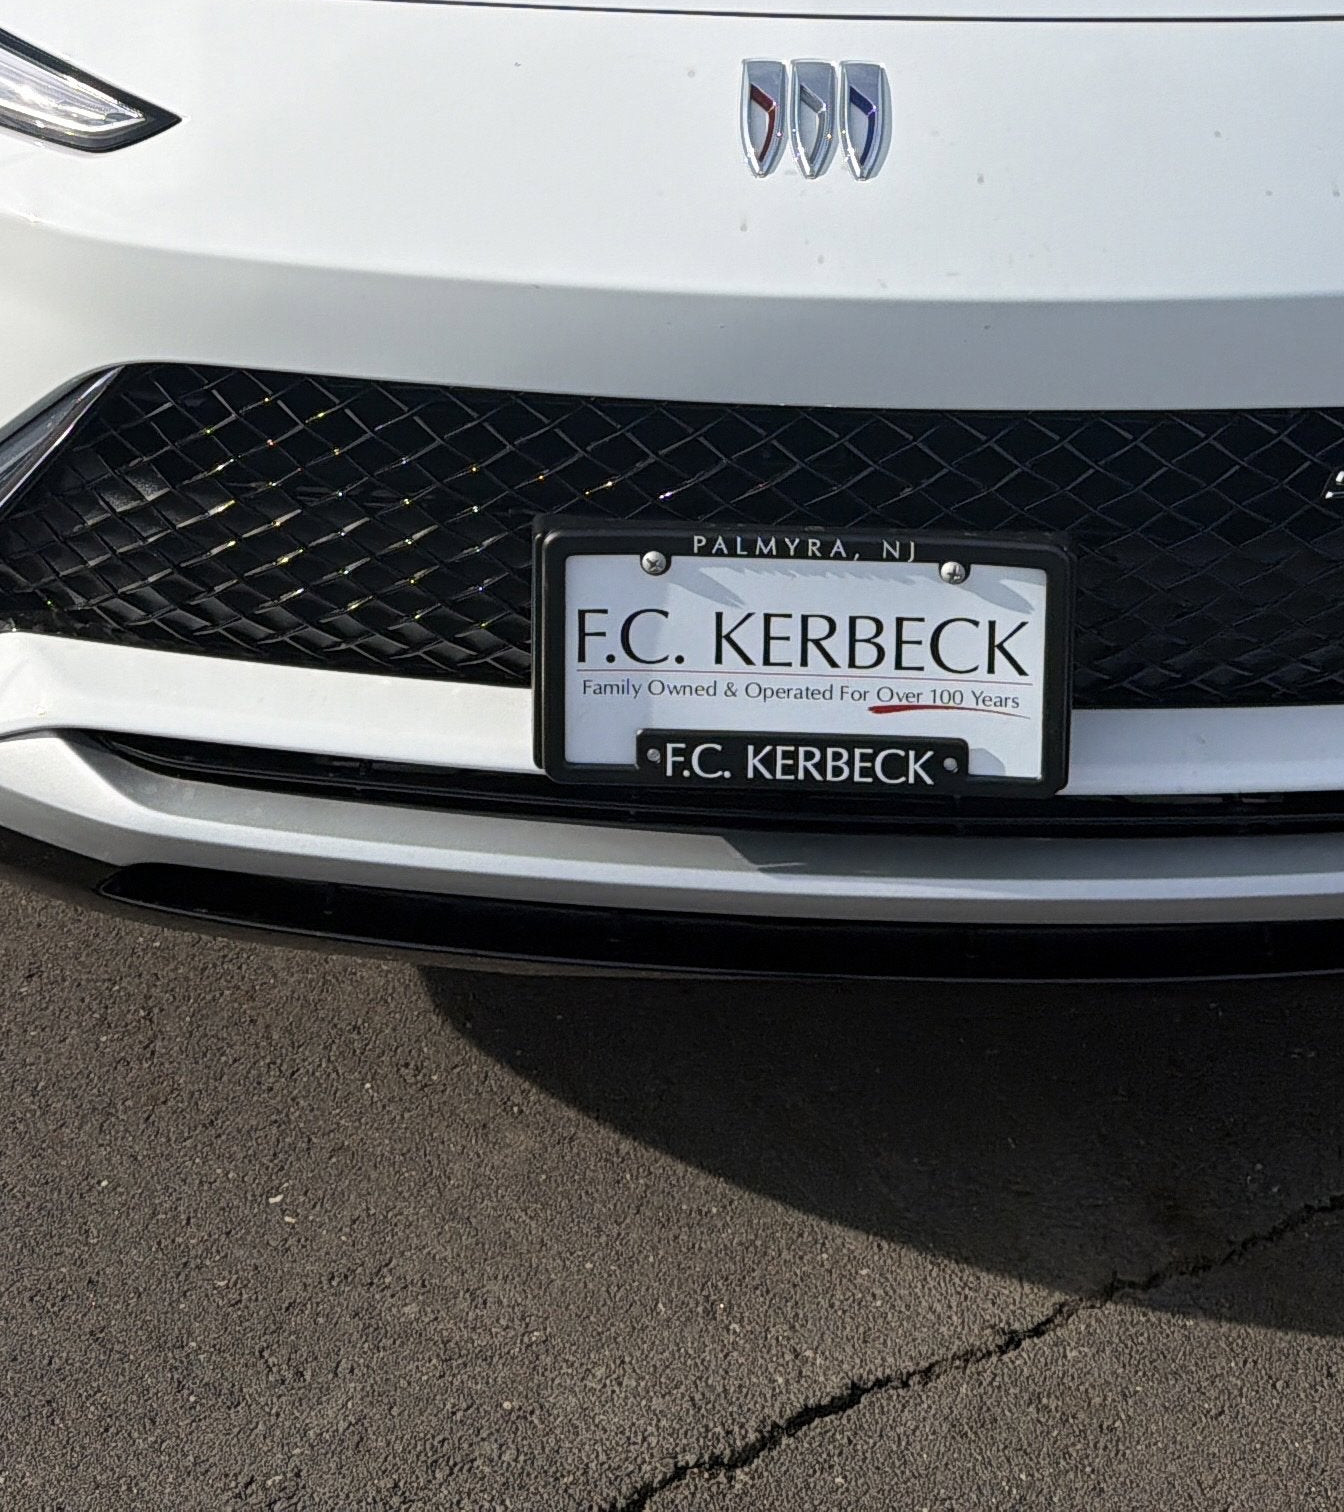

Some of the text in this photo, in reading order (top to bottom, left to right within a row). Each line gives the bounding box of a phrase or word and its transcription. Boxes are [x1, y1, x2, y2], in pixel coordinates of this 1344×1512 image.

[693, 535, 918, 564] PALMYRA, NJ
[577, 608, 1030, 676] F.C. KERBECK
[582, 678, 1021, 709] Family Owned & Operated For Over 100 Years
[664, 742, 935, 785] F.C. KERBECK
